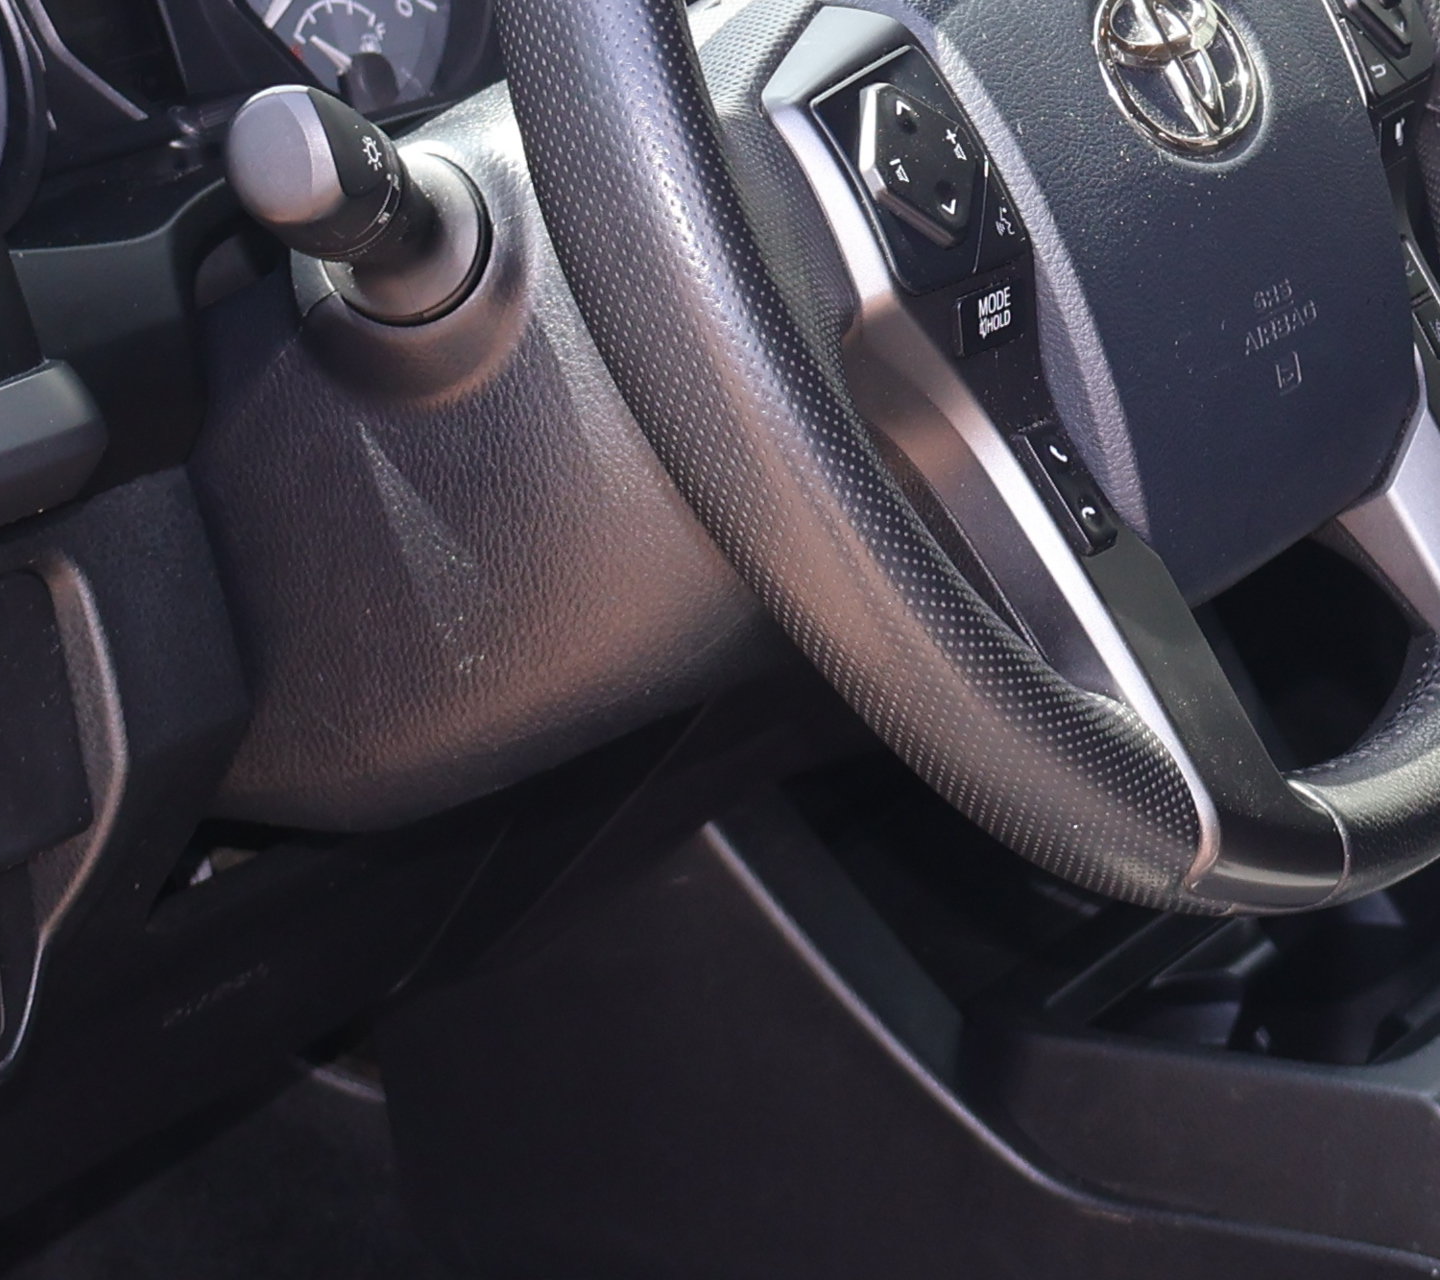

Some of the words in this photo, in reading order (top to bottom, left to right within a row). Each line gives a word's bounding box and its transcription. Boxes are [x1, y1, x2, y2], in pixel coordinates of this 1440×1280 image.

[978, 286, 1011, 319] MODE
[987, 309, 1011, 334] HOLD
[1245, 300, 1318, 356] AIRBAG
